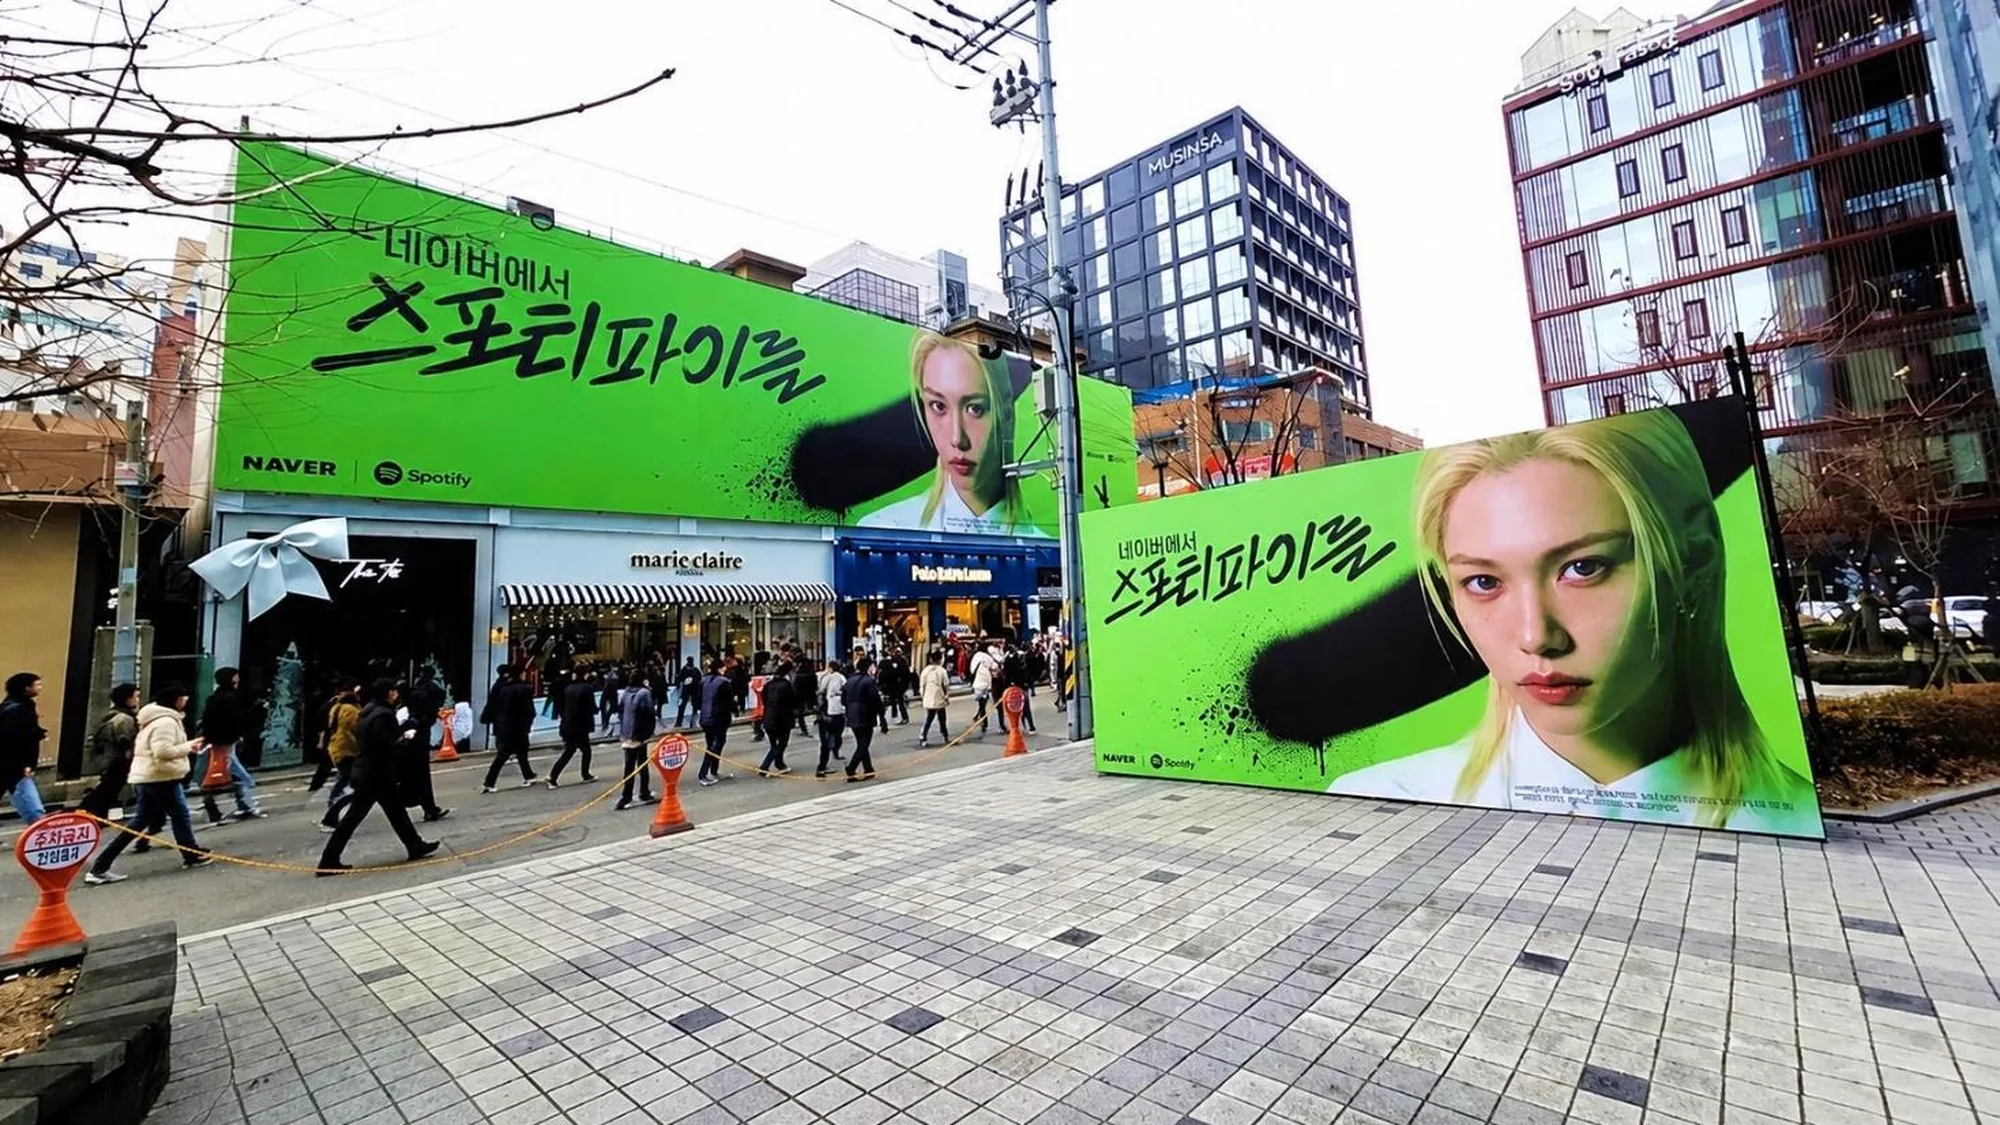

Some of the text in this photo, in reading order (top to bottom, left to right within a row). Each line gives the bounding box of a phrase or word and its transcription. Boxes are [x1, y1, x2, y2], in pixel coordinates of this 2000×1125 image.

[1148, 131, 1223, 176] MUSINSA
[384, 228, 571, 301] 네이버에서
[311, 272, 826, 404] 스포티파이를
[243, 456, 472, 488] NAVER Spotify
[630, 550, 743, 569] marie claire
[1118, 531, 1197, 560] 네이버에서
[1104, 514, 1396, 625] 스포티파이를
[1103, 753, 1136, 764] NAVER
